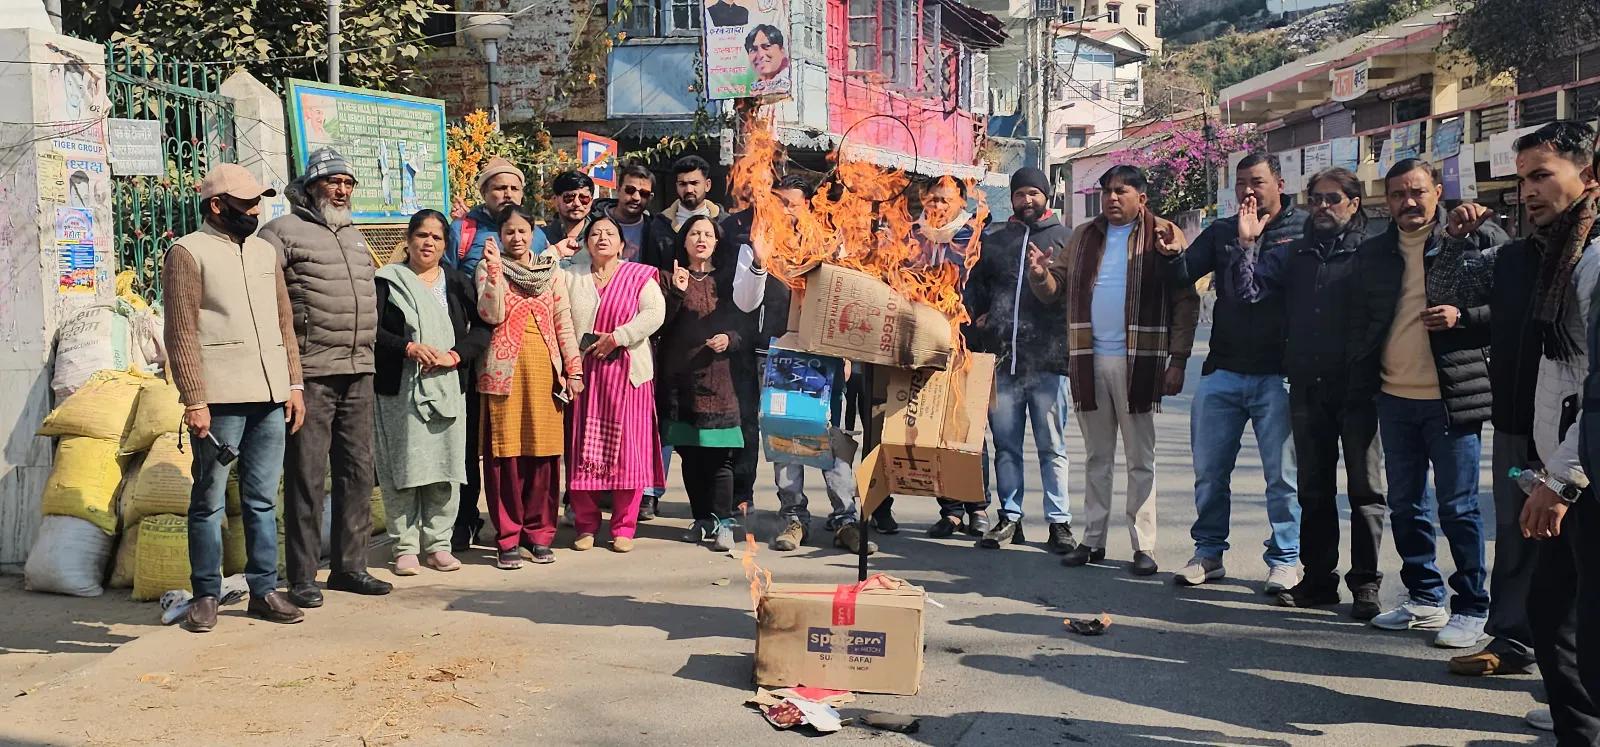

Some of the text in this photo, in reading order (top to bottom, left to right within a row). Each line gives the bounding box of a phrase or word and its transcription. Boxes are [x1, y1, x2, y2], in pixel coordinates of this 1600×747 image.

[53, 140, 76, 150] TIGER
[78, 143, 103, 153] GROUP
[826, 276, 844, 340] EGG WITH CARE
[880, 314, 895, 353] EGGS
[848, 655, 872, 664] SAFAI
